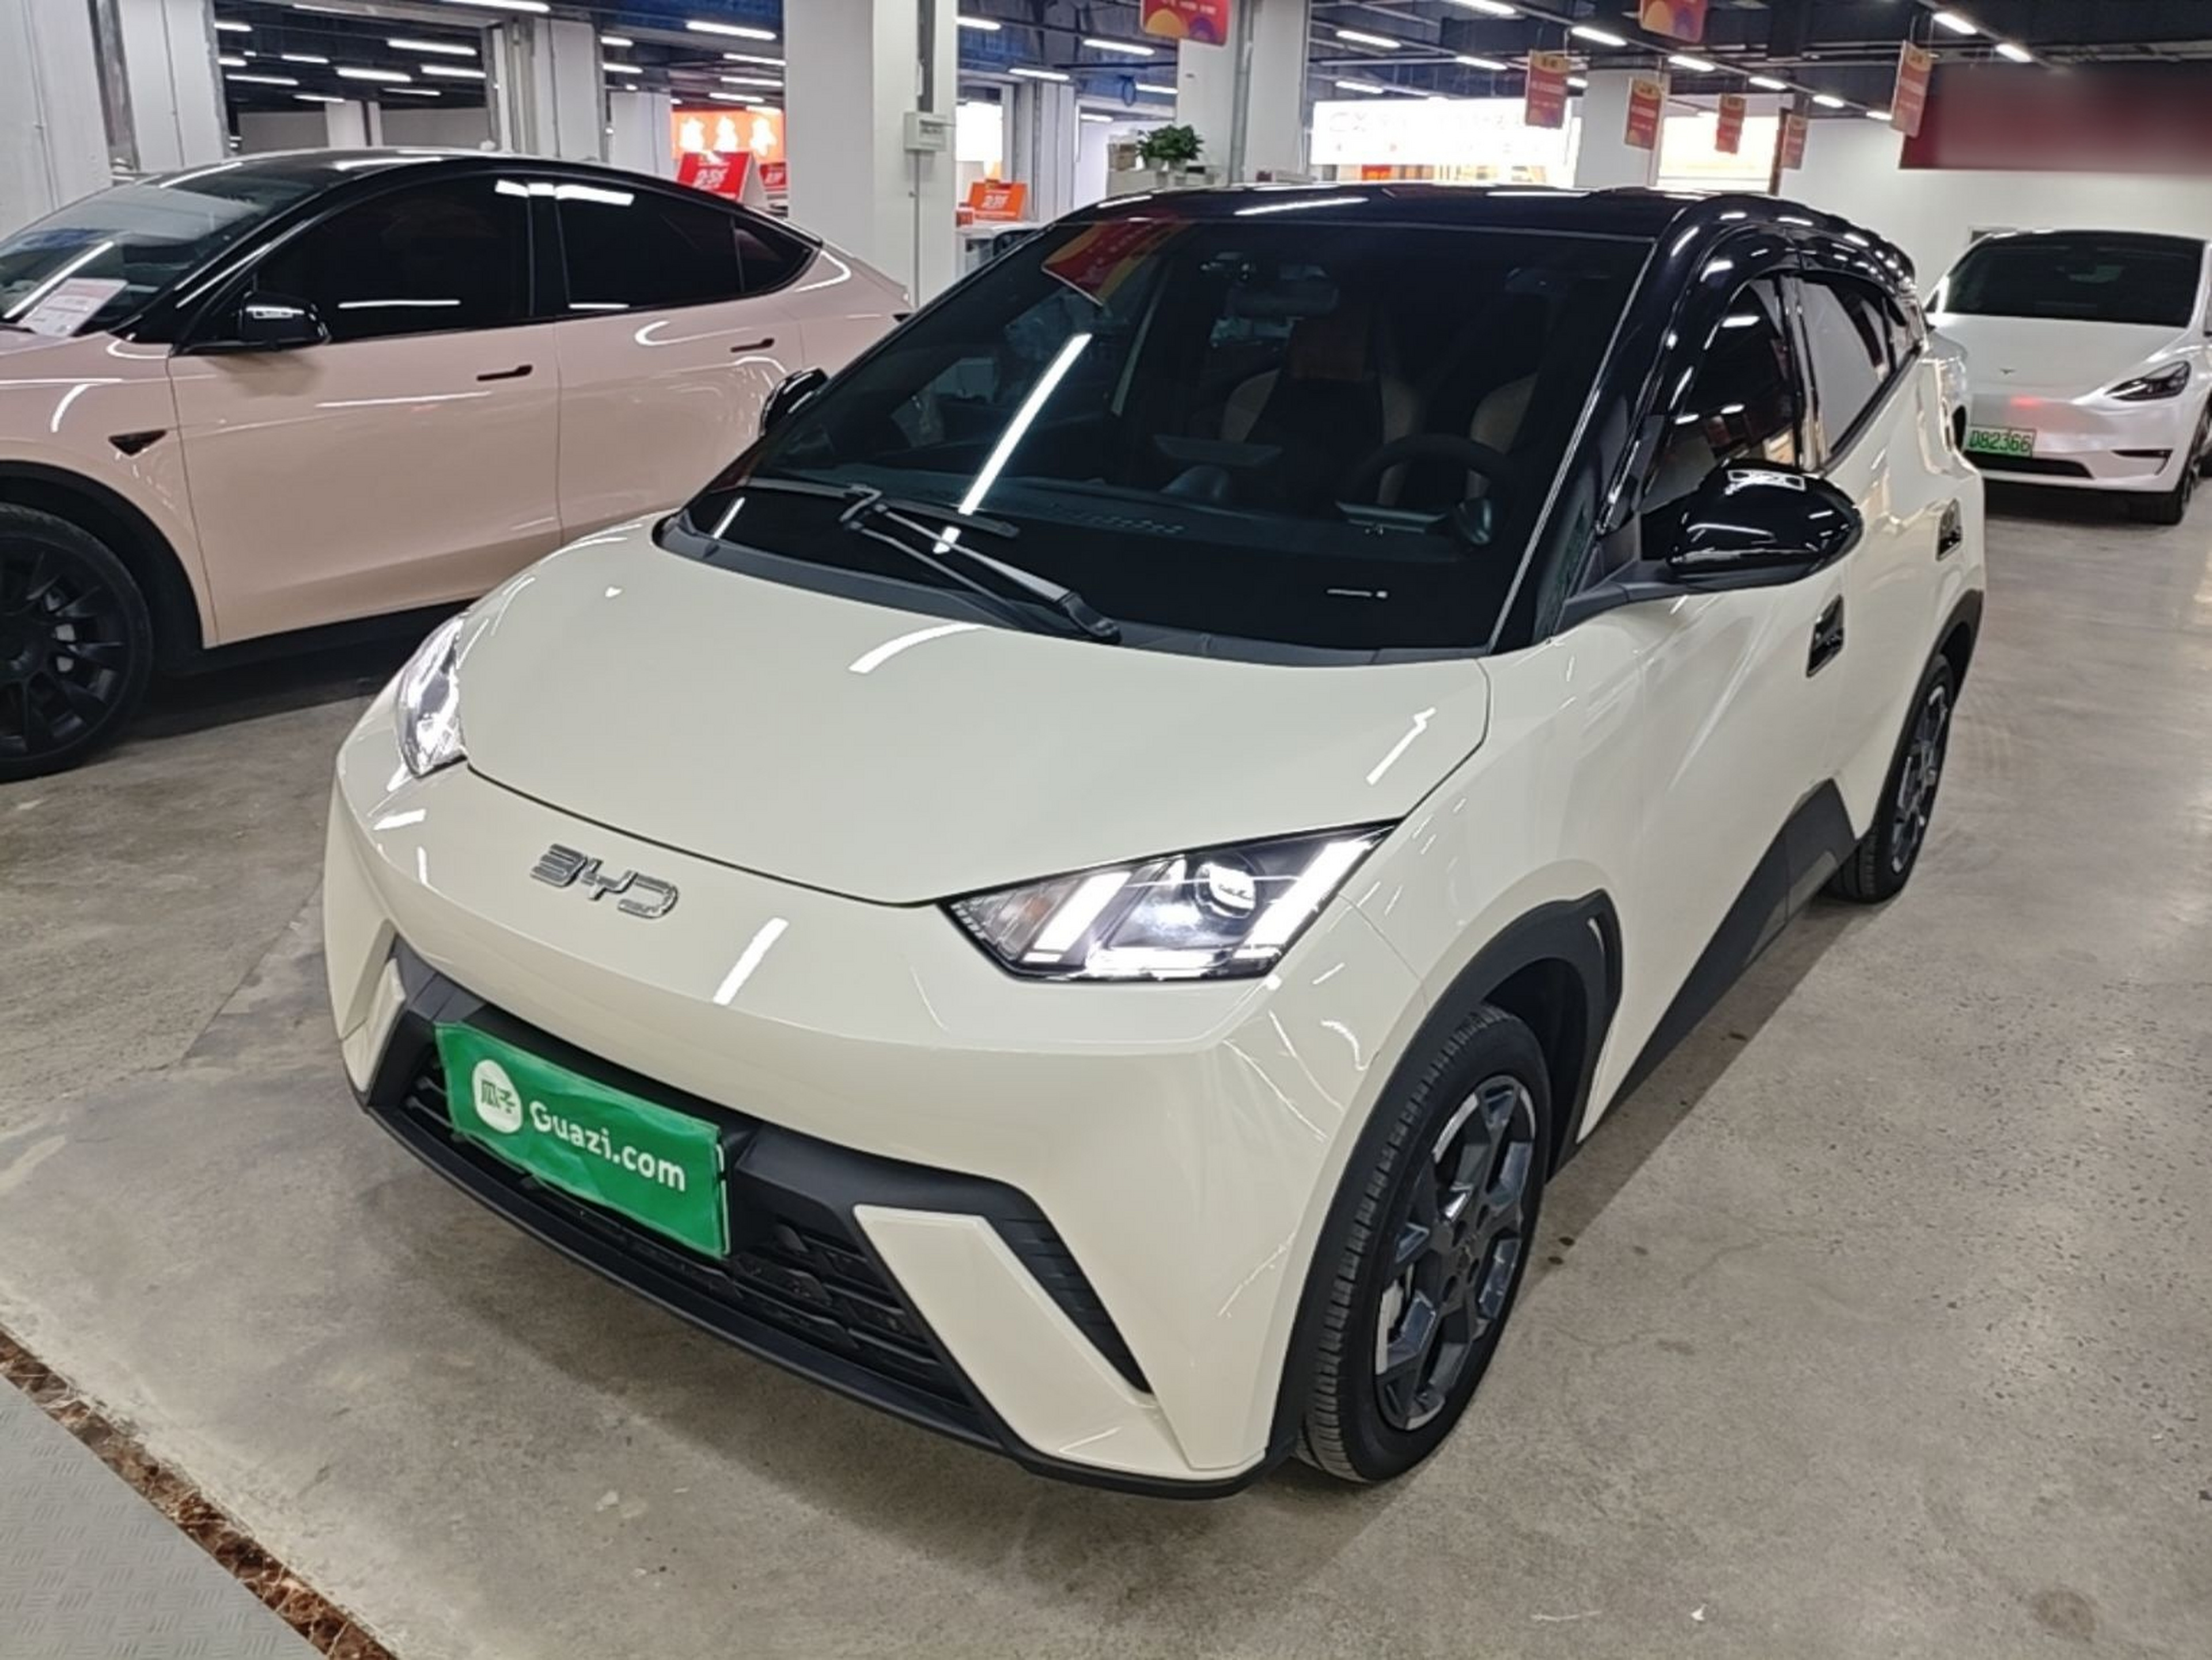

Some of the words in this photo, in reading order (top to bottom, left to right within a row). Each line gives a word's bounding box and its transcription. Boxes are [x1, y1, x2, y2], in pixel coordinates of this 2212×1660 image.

[529, 844, 679, 919] BYD
[481, 1079, 516, 1114] 瓜子
[529, 1100, 685, 1192] Guazi.com
